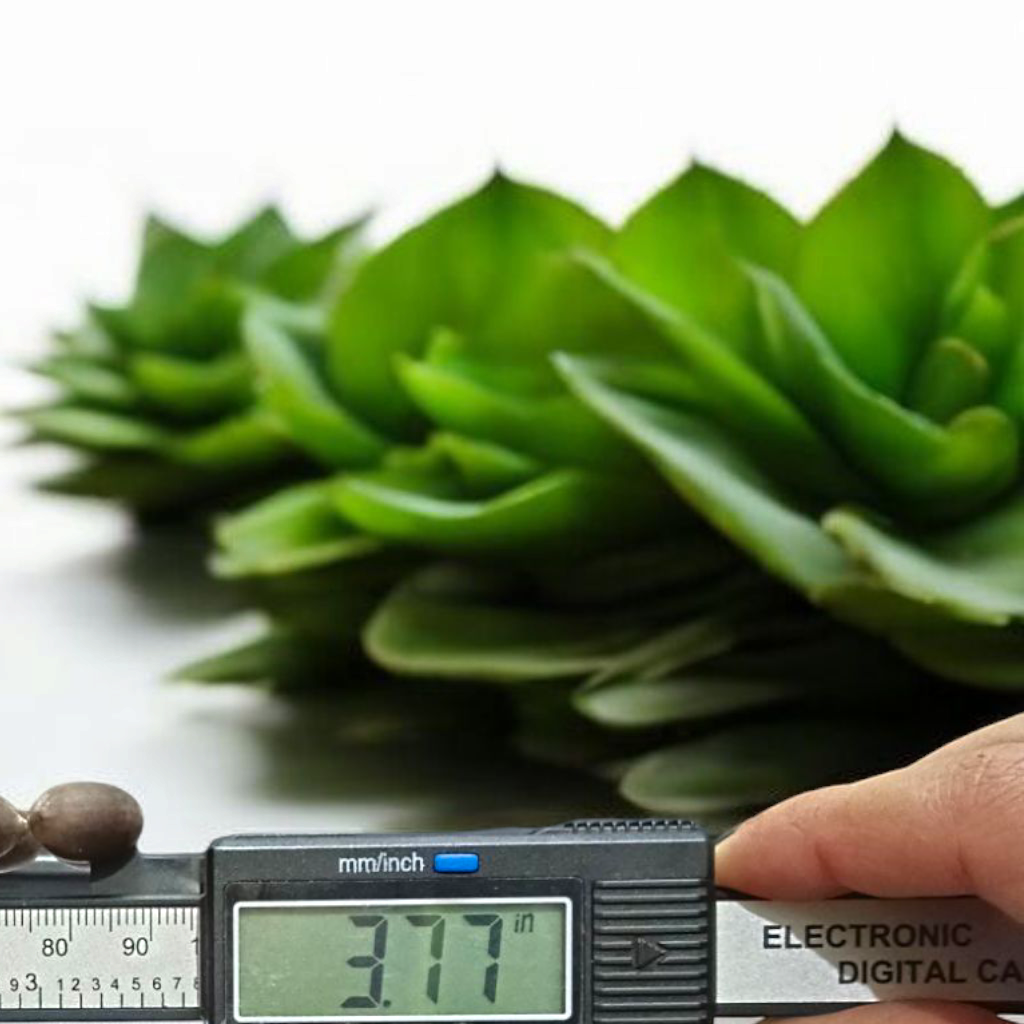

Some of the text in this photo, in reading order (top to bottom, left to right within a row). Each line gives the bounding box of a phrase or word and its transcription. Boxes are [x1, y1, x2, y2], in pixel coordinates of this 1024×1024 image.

[338, 852, 426, 875] mm/inch
[41, 937, 69, 958] 80
[121, 936, 150, 957] 90
[762, 922, 973, 949] ELECTRONIC
[340, 911, 535, 1009] 3.77 in
[837, 958, 1024, 985] DIGITAL CA
[9, 977, 20, 993] 9
[25, 972, 39, 992] 3
[70, 976, 81, 992] 2
[91, 976, 102, 992] 3
[109, 977, 120, 991] 4
[131, 976, 142, 992] 5
[152, 976, 162, 992] 6
[172, 976, 183, 991] 7
